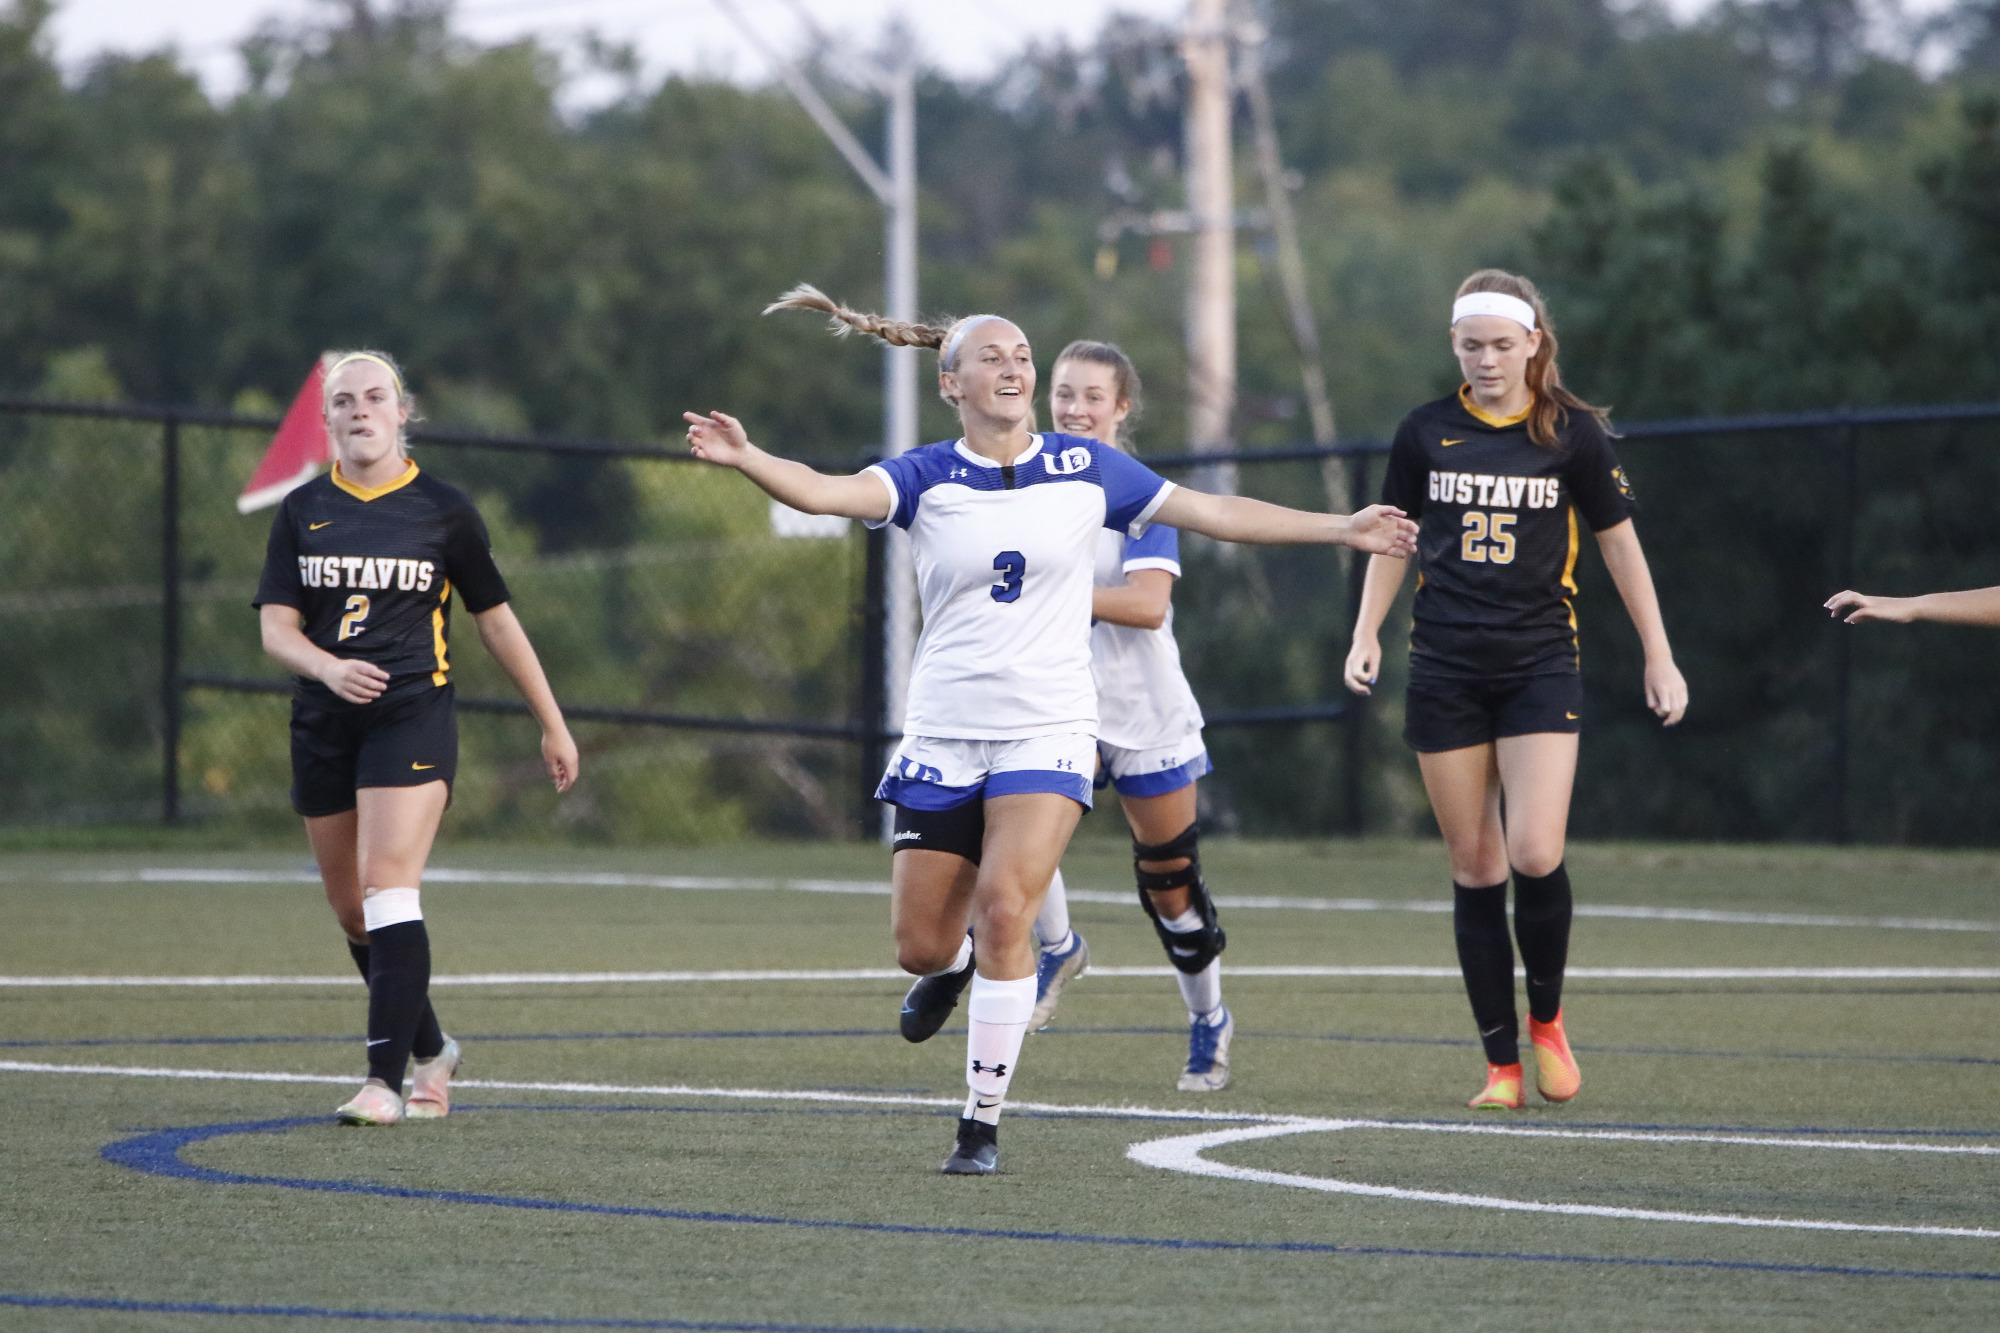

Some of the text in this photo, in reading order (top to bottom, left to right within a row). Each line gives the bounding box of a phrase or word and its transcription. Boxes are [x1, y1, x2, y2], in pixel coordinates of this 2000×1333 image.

[1429, 470, 1558, 509] GUSTAVUS
[1461, 511, 1518, 565] 25
[990, 551, 1026, 603] 3
[338, 594, 370, 642] 2
